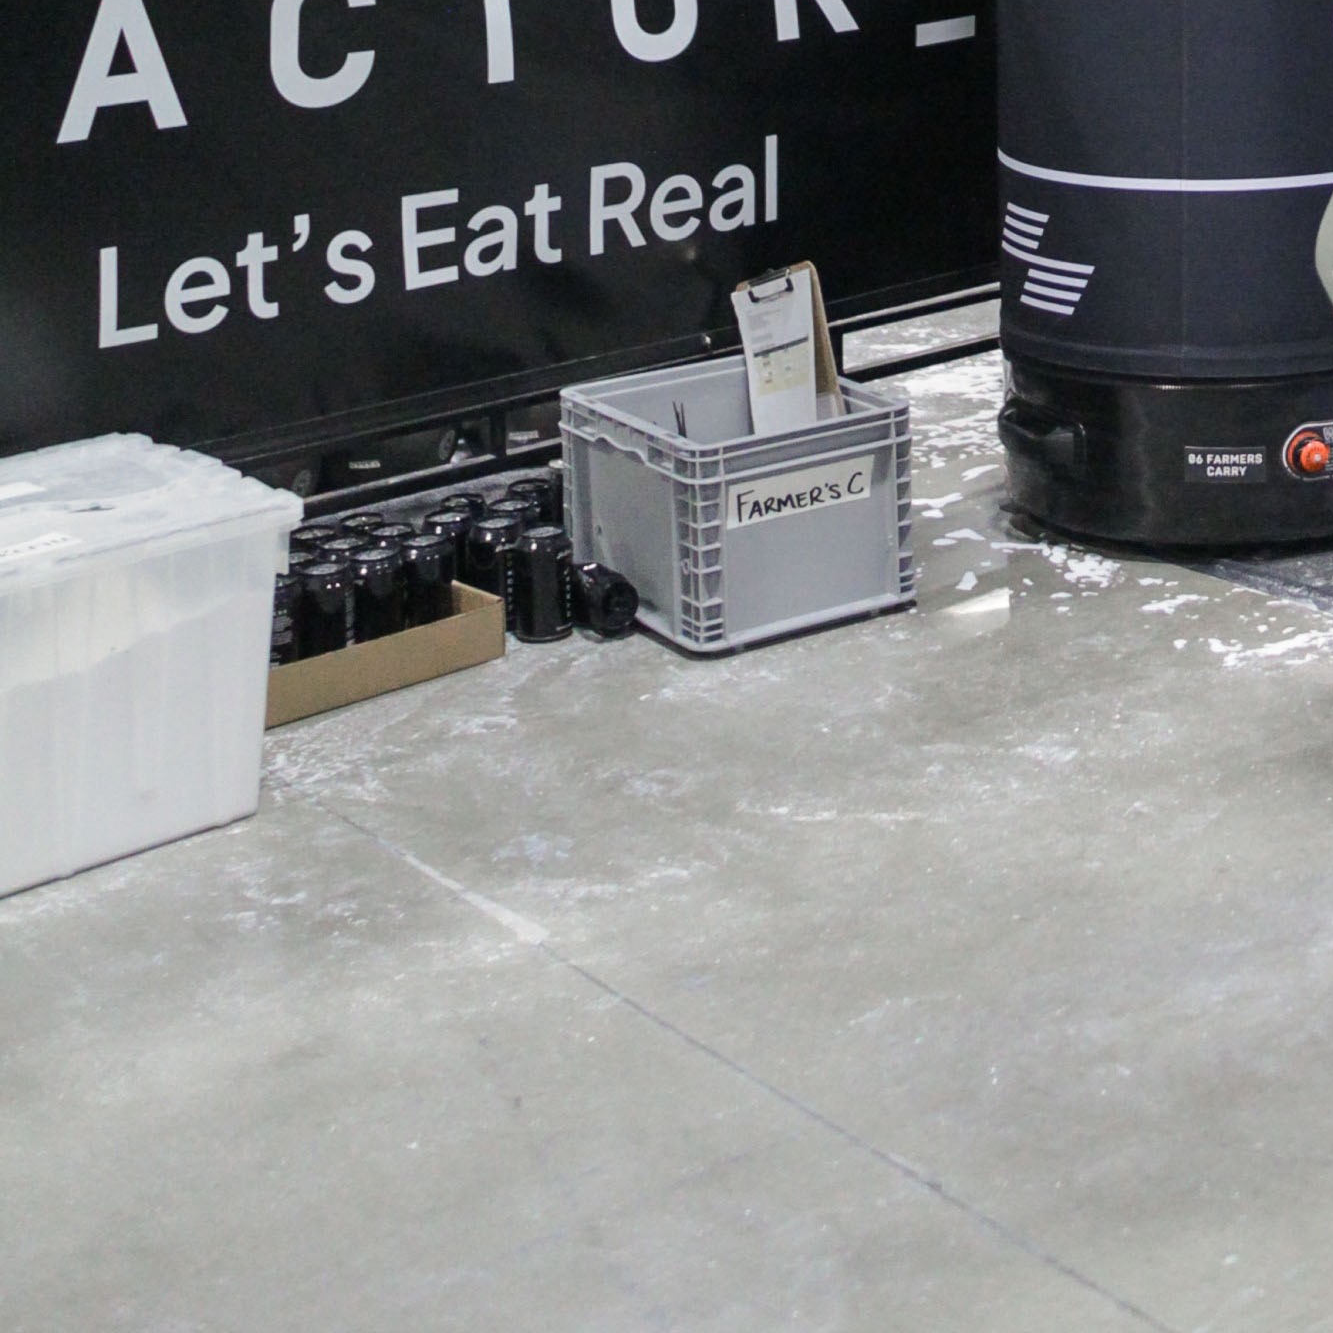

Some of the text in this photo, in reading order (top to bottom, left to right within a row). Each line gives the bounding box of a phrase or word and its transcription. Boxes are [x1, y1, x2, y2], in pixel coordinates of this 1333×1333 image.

[98, 134, 779, 349] Let’s Eat Real
[1206, 452, 1263, 465] FARMERS
[1206, 465, 1247, 478] CARRY
[736, 471, 864, 523] FARMER'S C
